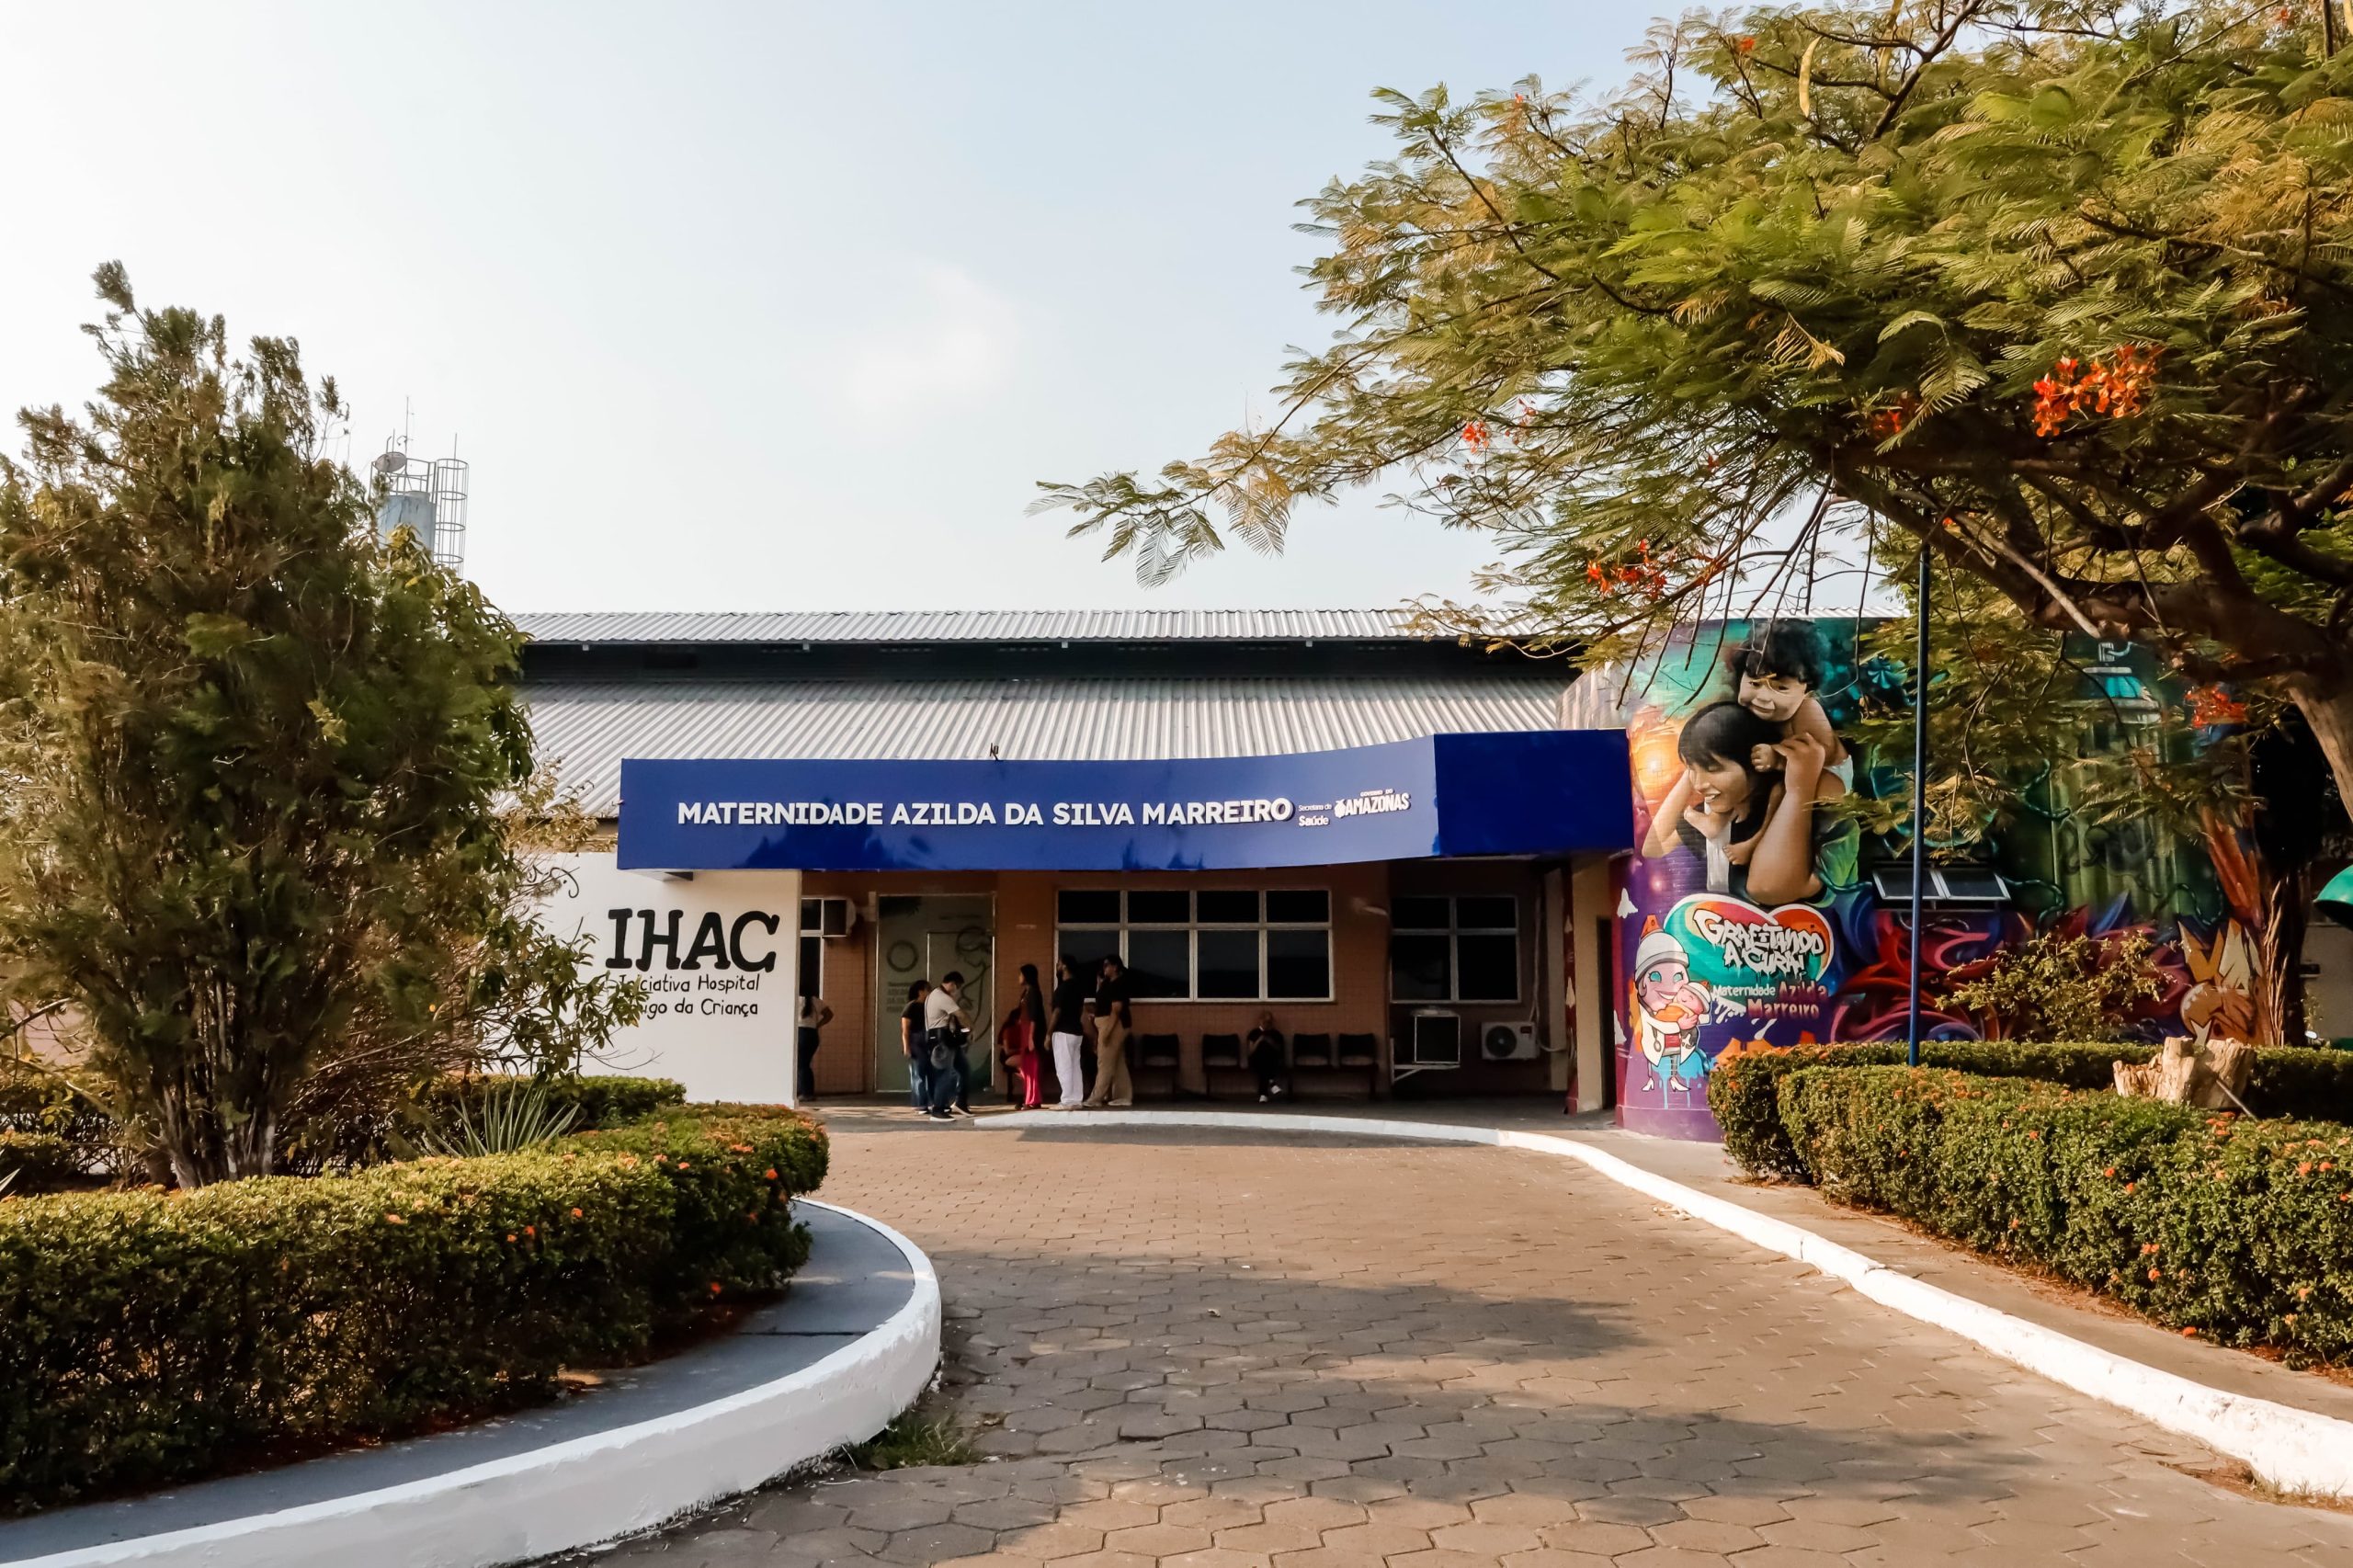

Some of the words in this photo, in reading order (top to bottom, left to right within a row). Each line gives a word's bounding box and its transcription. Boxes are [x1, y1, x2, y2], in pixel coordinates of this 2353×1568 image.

[678, 802, 883, 825] MATERNIDADE
[891, 802, 997, 825] AZILDA
[1005, 803, 1044, 825] DA
[1051, 802, 1134, 826] SILVA
[1142, 797, 1293, 825] MARREIRO
[1345, 793, 1410, 816] AMAZONAS
[1299, 815, 1329, 826] Saúde
[606, 908, 780, 972] IHAC
[1722, 941, 1744, 968] A
[698, 973, 760, 994] Hospital
[1711, 983, 1776, 998] Maternidade
[1779, 981, 1828, 1000] Azilda
[674, 996, 694, 1015] da
[700, 998, 758, 1017] Criança
[1746, 998, 1820, 1019] Marreiro
